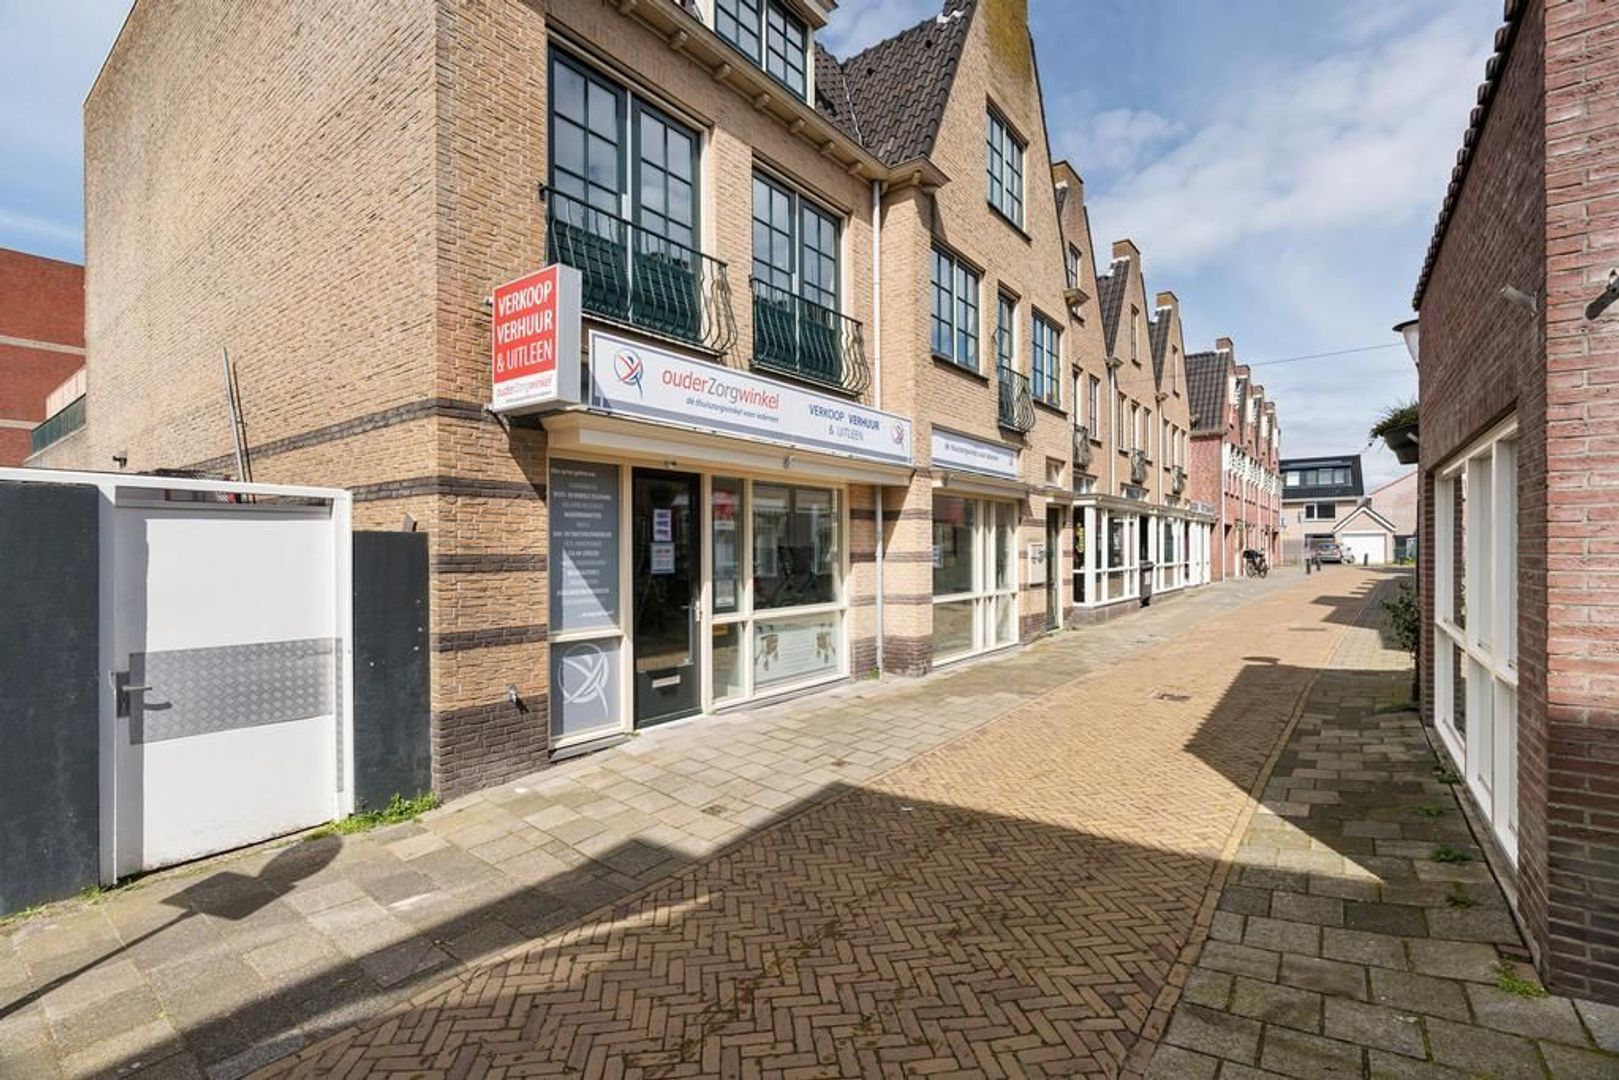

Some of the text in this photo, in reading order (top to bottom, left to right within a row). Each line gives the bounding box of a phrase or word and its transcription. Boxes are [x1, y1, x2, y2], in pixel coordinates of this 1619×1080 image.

[498, 280, 553, 318] VERKOOP
[497, 309, 553, 345] VERHUUR
[497, 338, 553, 374] & UITLEEN
[662, 370, 780, 409] ouderZorgwinkel
[809, 404, 880, 431] VERKOOP VERHUUR
[837, 427, 864, 441] UITLEEN
